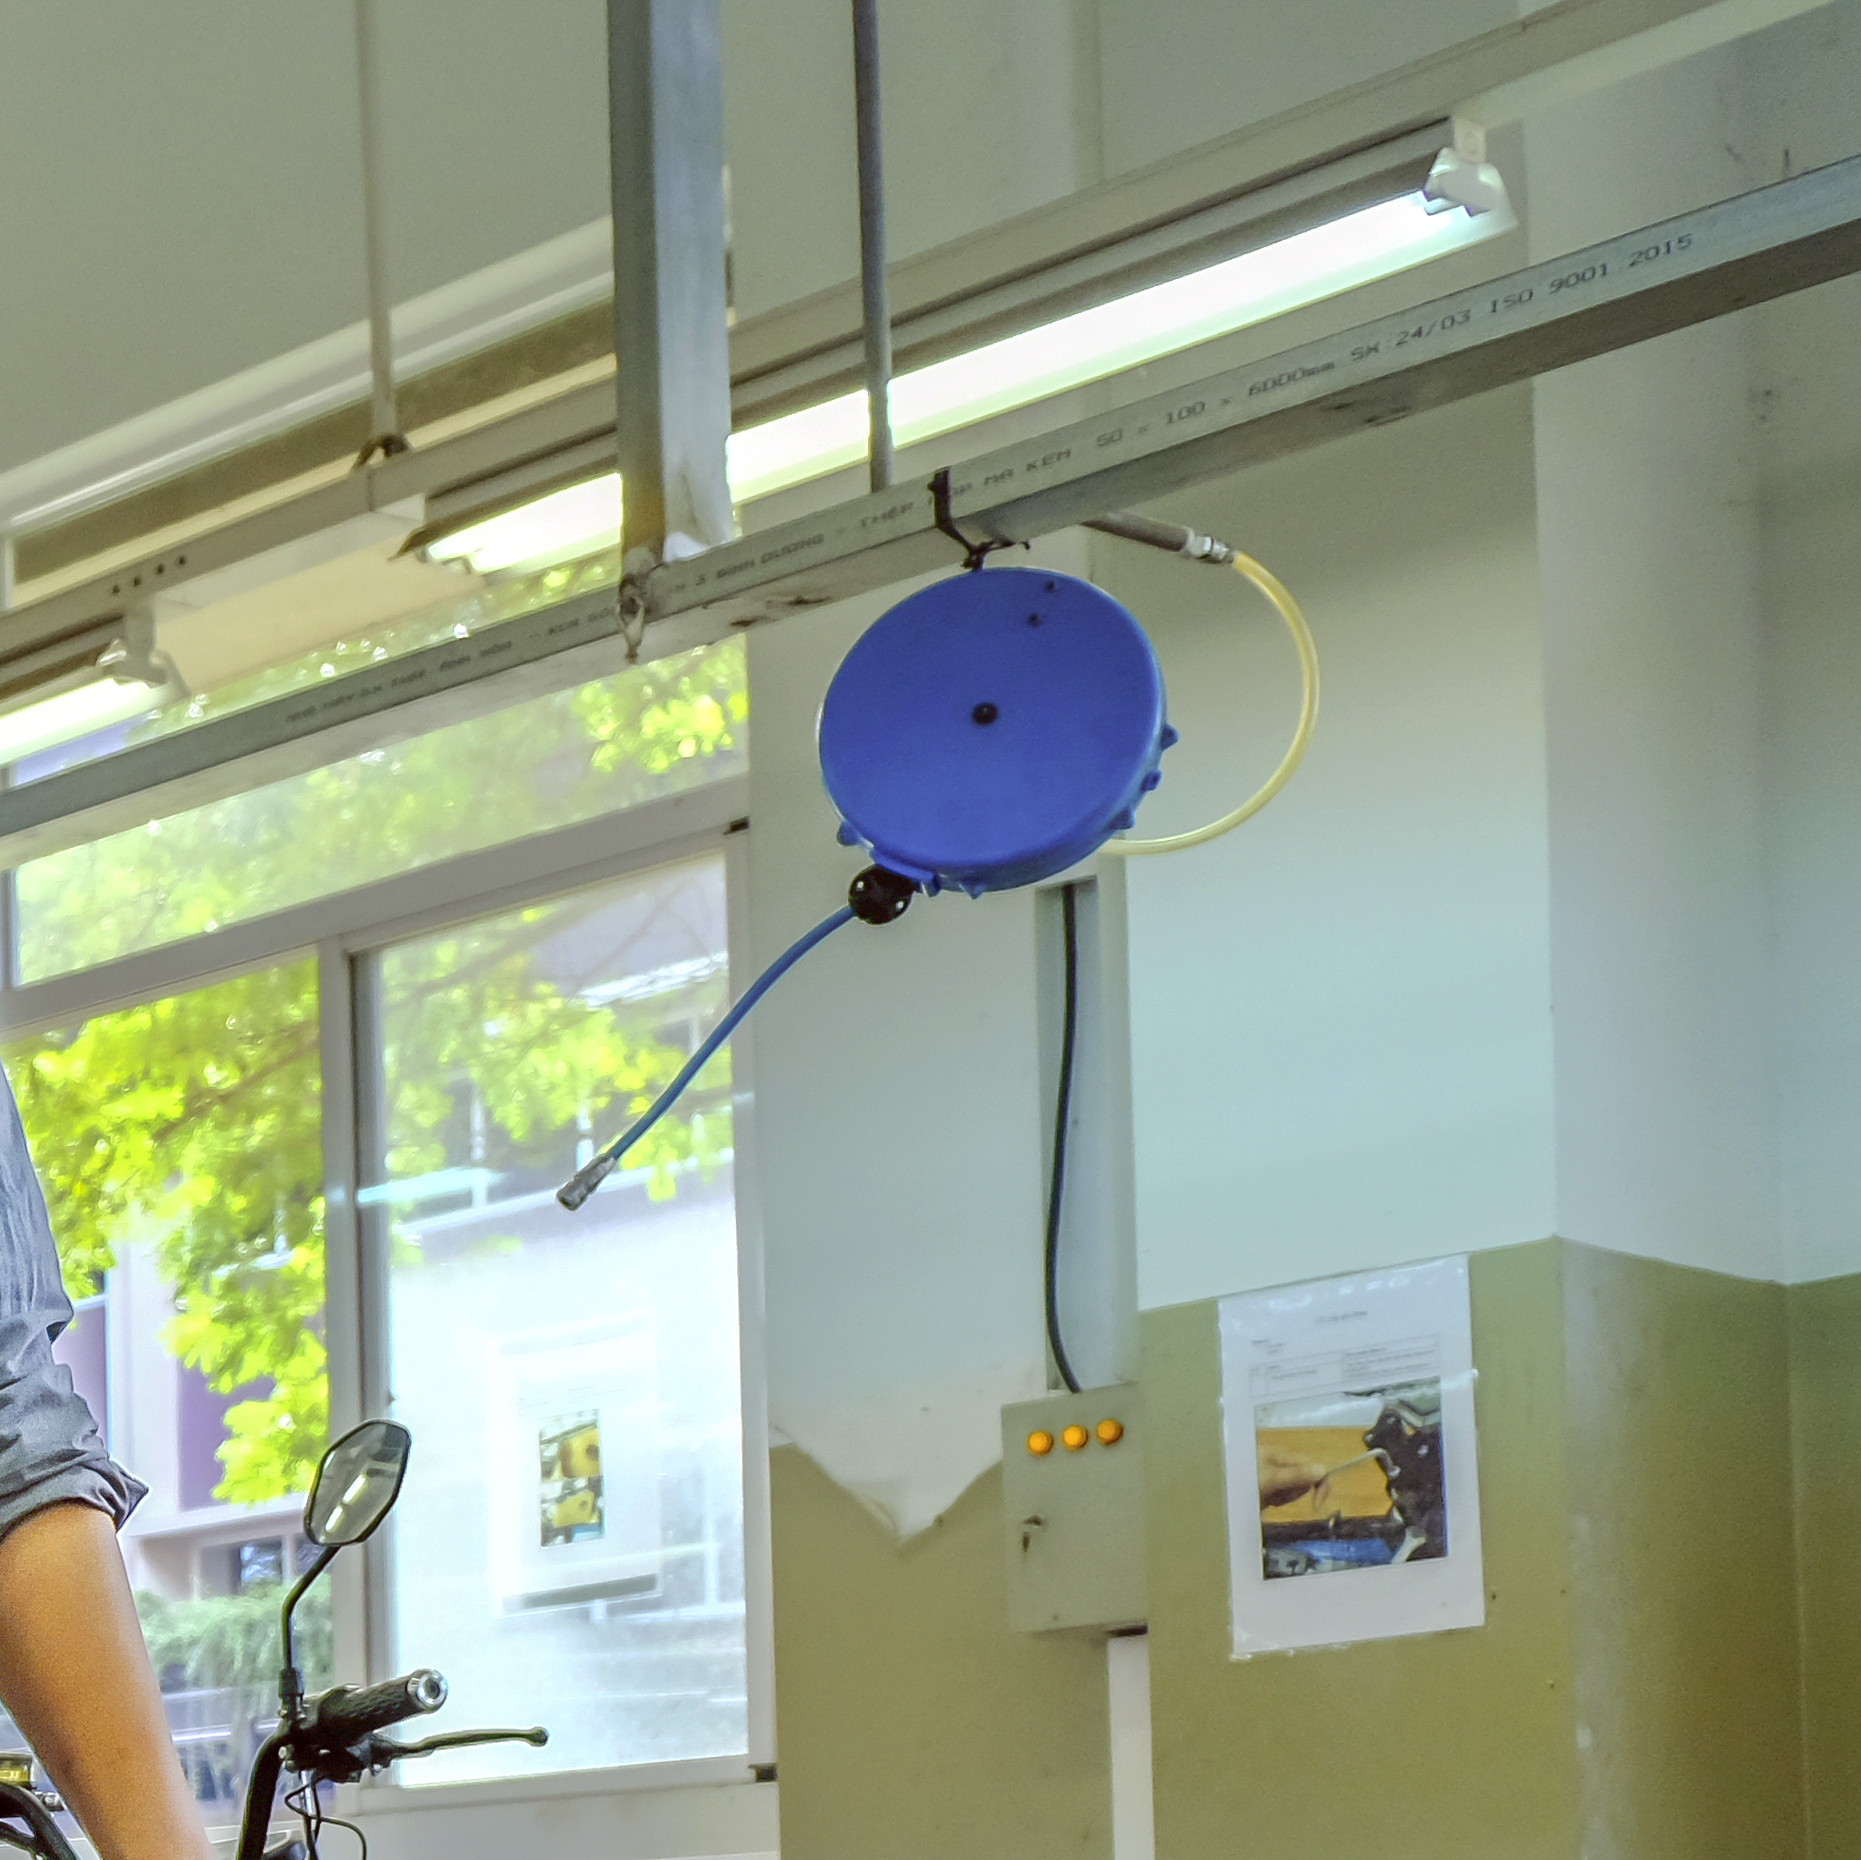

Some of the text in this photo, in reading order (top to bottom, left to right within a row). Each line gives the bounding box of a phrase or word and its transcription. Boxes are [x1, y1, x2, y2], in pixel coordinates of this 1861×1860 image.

[1095, 428, 1124, 447] 50
[1165, 401, 1206, 424] 100
[1395, 308, 1472, 346] 24/03
[1489, 287, 1534, 314] ISO
[1549, 262, 1608, 295] 9001
[1628, 232, 1694, 268] 2015
